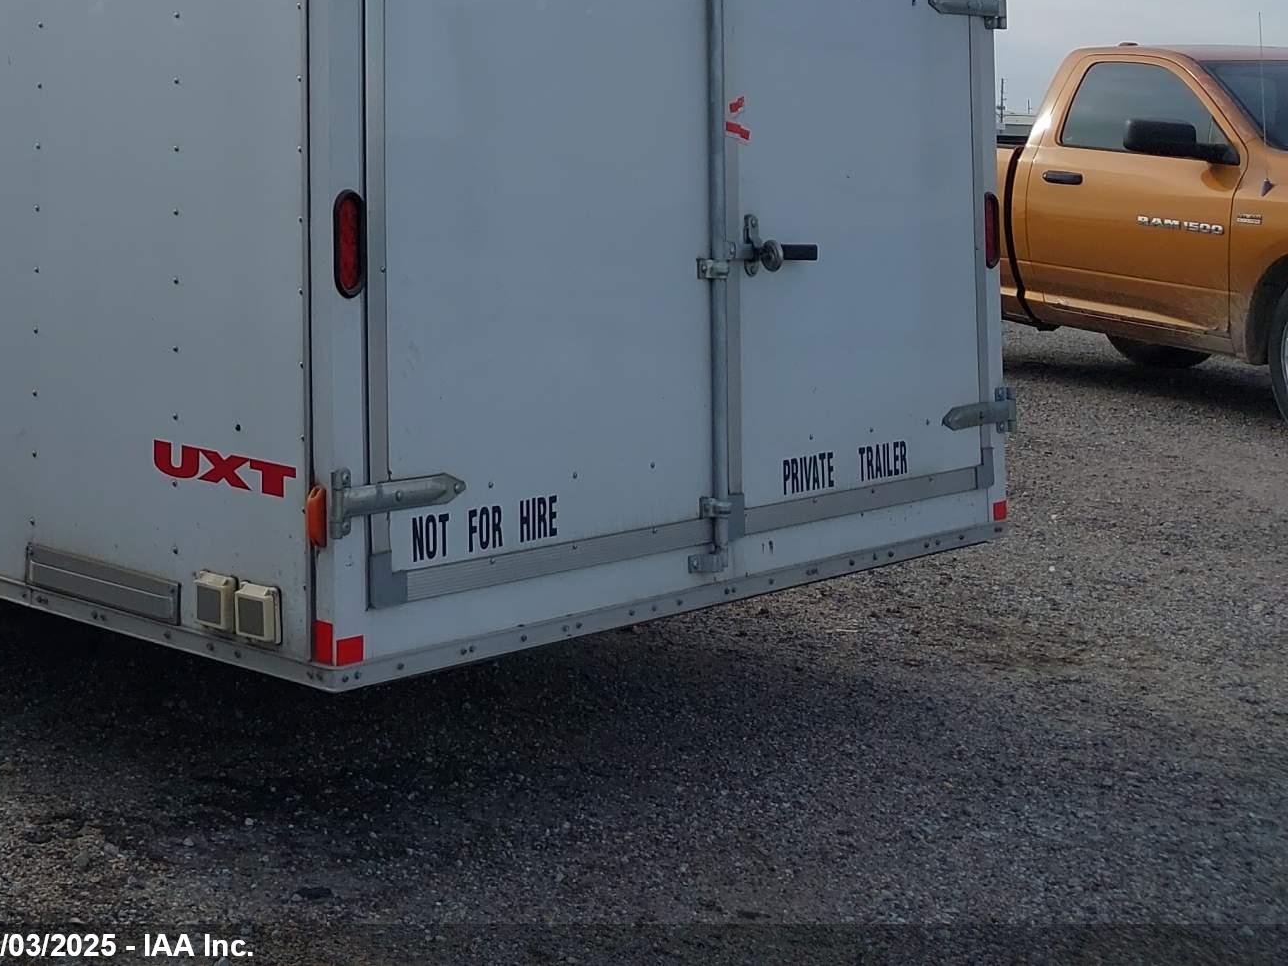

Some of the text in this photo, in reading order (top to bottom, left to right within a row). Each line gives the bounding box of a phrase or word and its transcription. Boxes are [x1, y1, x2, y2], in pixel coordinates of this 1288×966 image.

[1137, 215, 1225, 235] RAM 1500
[153, 439, 296, 498] UXT
[783, 440, 908, 495] PRIVATE TRAILER
[412, 495, 558, 562] NOT FOR HIRE
